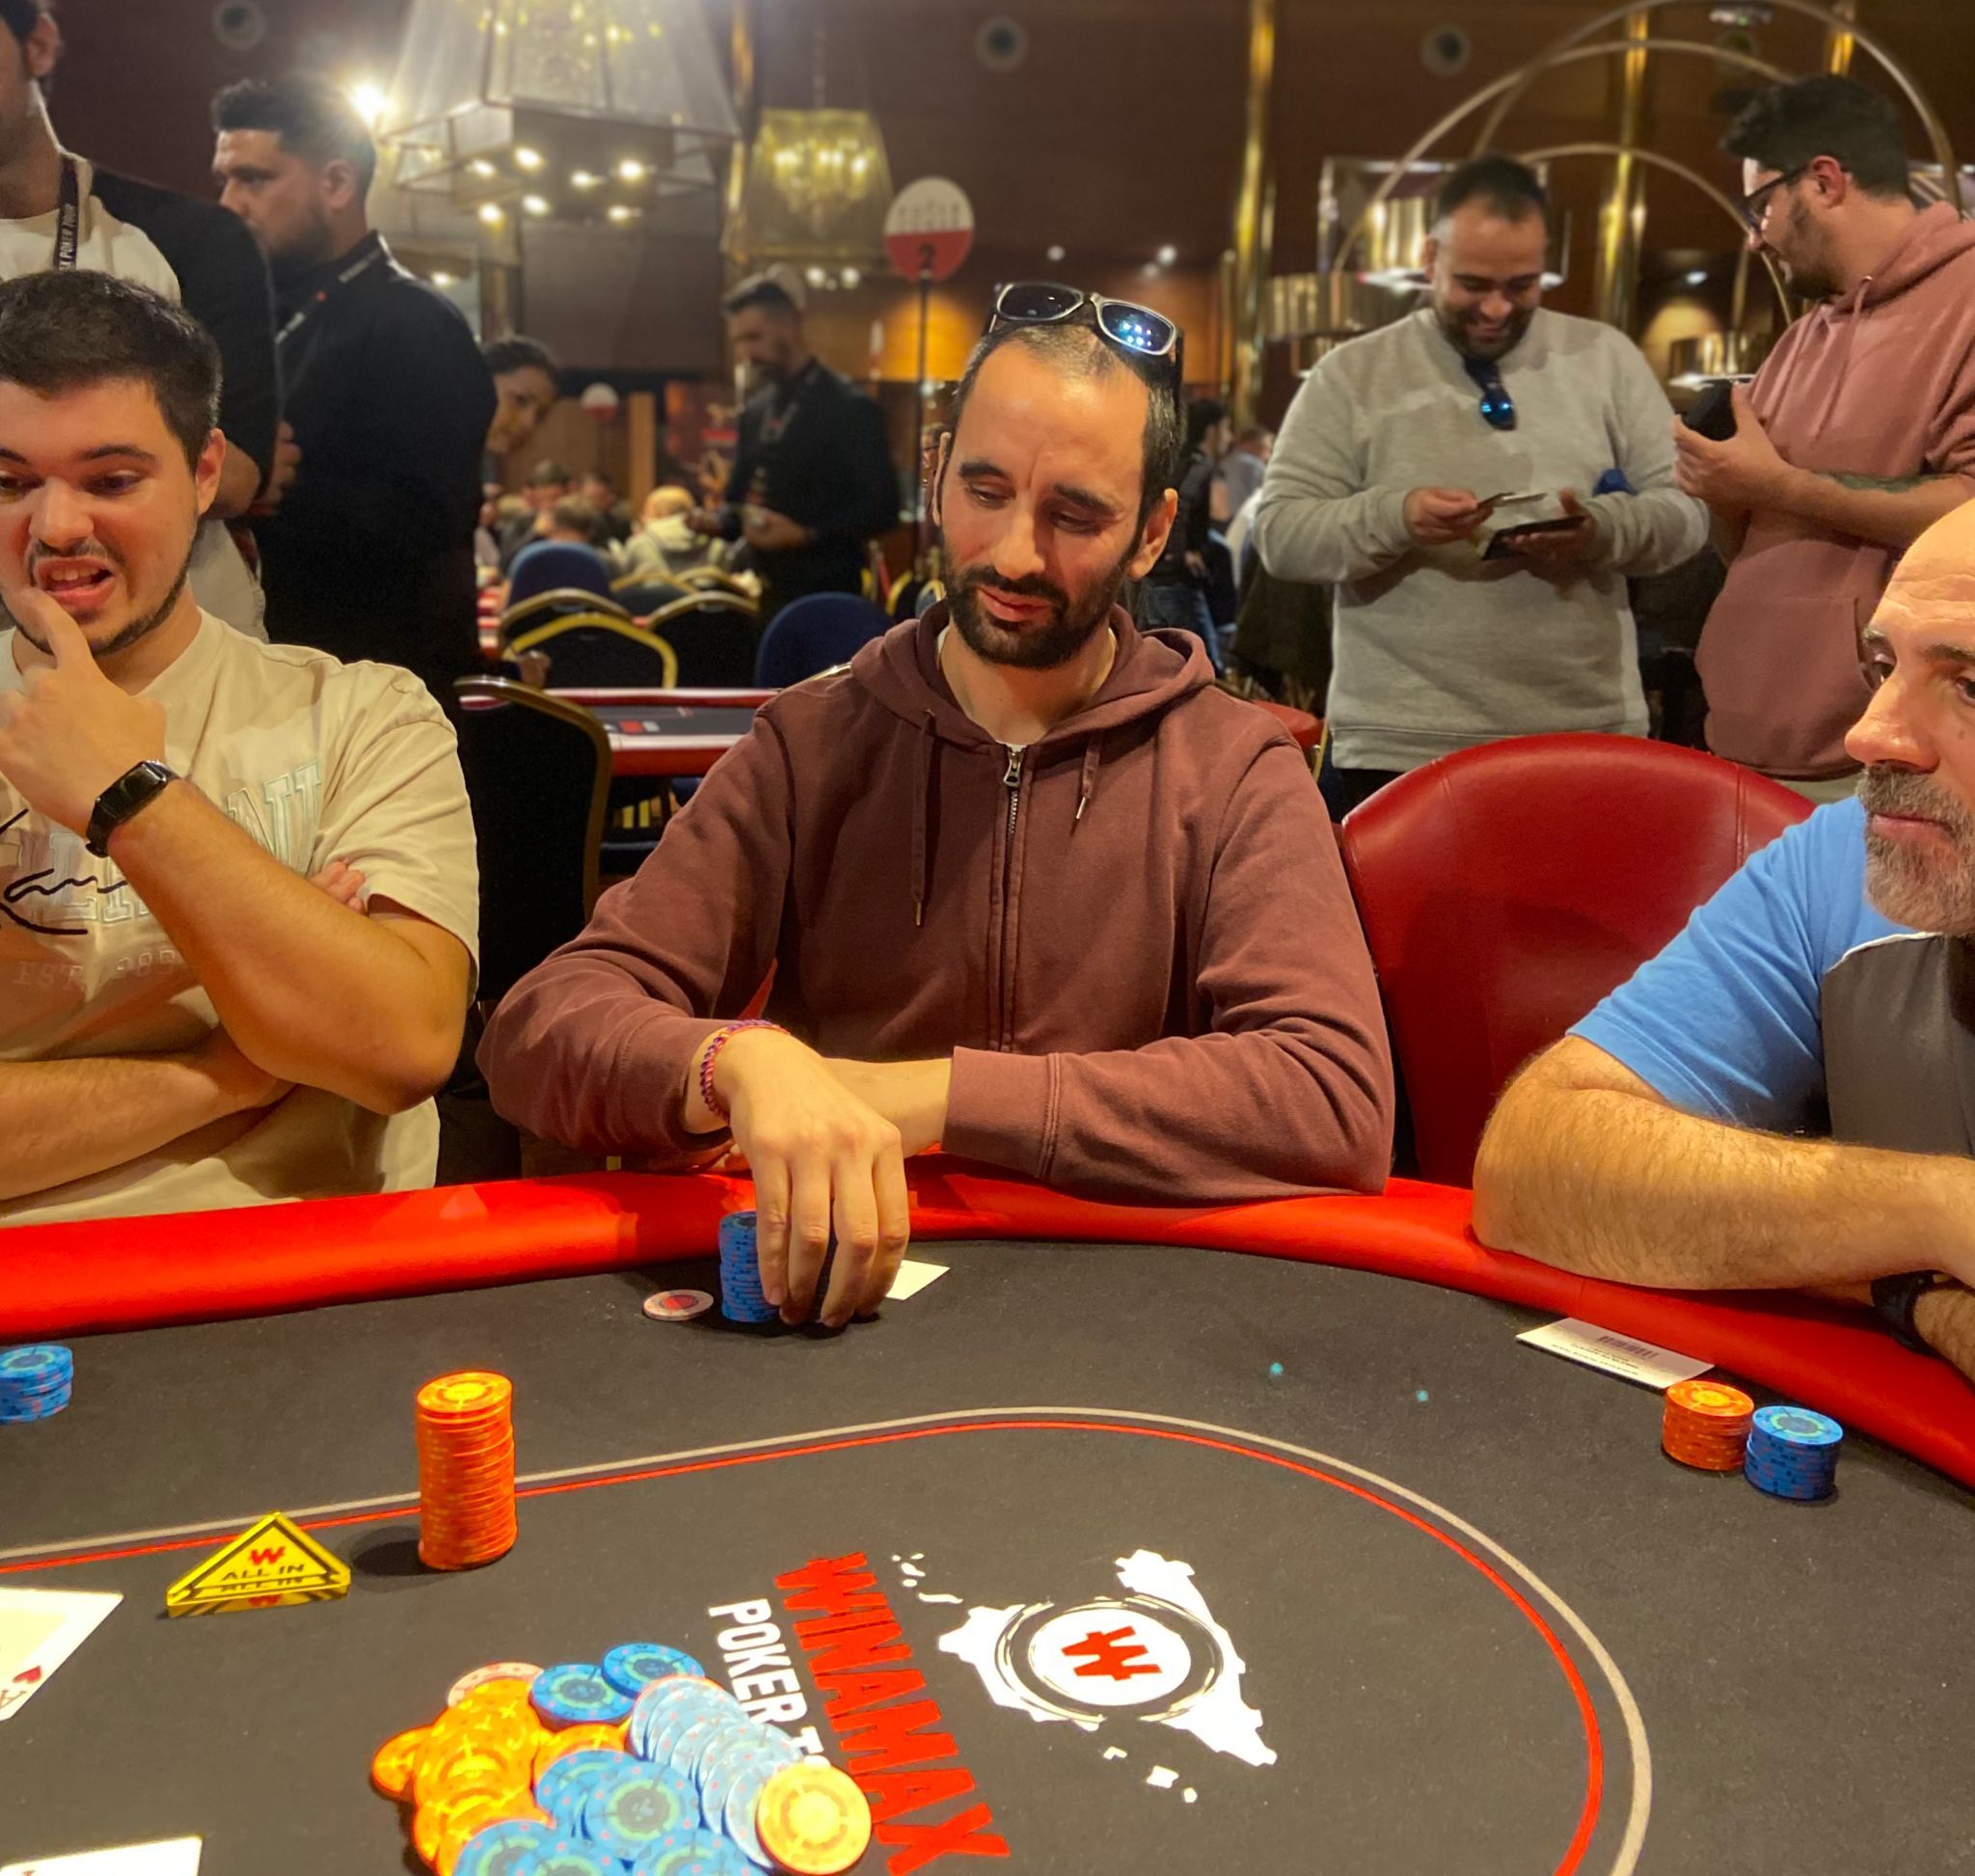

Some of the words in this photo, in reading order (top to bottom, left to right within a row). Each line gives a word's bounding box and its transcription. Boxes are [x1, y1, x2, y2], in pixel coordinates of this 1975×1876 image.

[59, 228, 73, 259] POKER
[221, 1568, 270, 1582] ALL
[278, 1563, 305, 1576] IN
[708, 1598, 808, 1725] POKER
[774, 1552, 1011, 1876] WINAMAX
